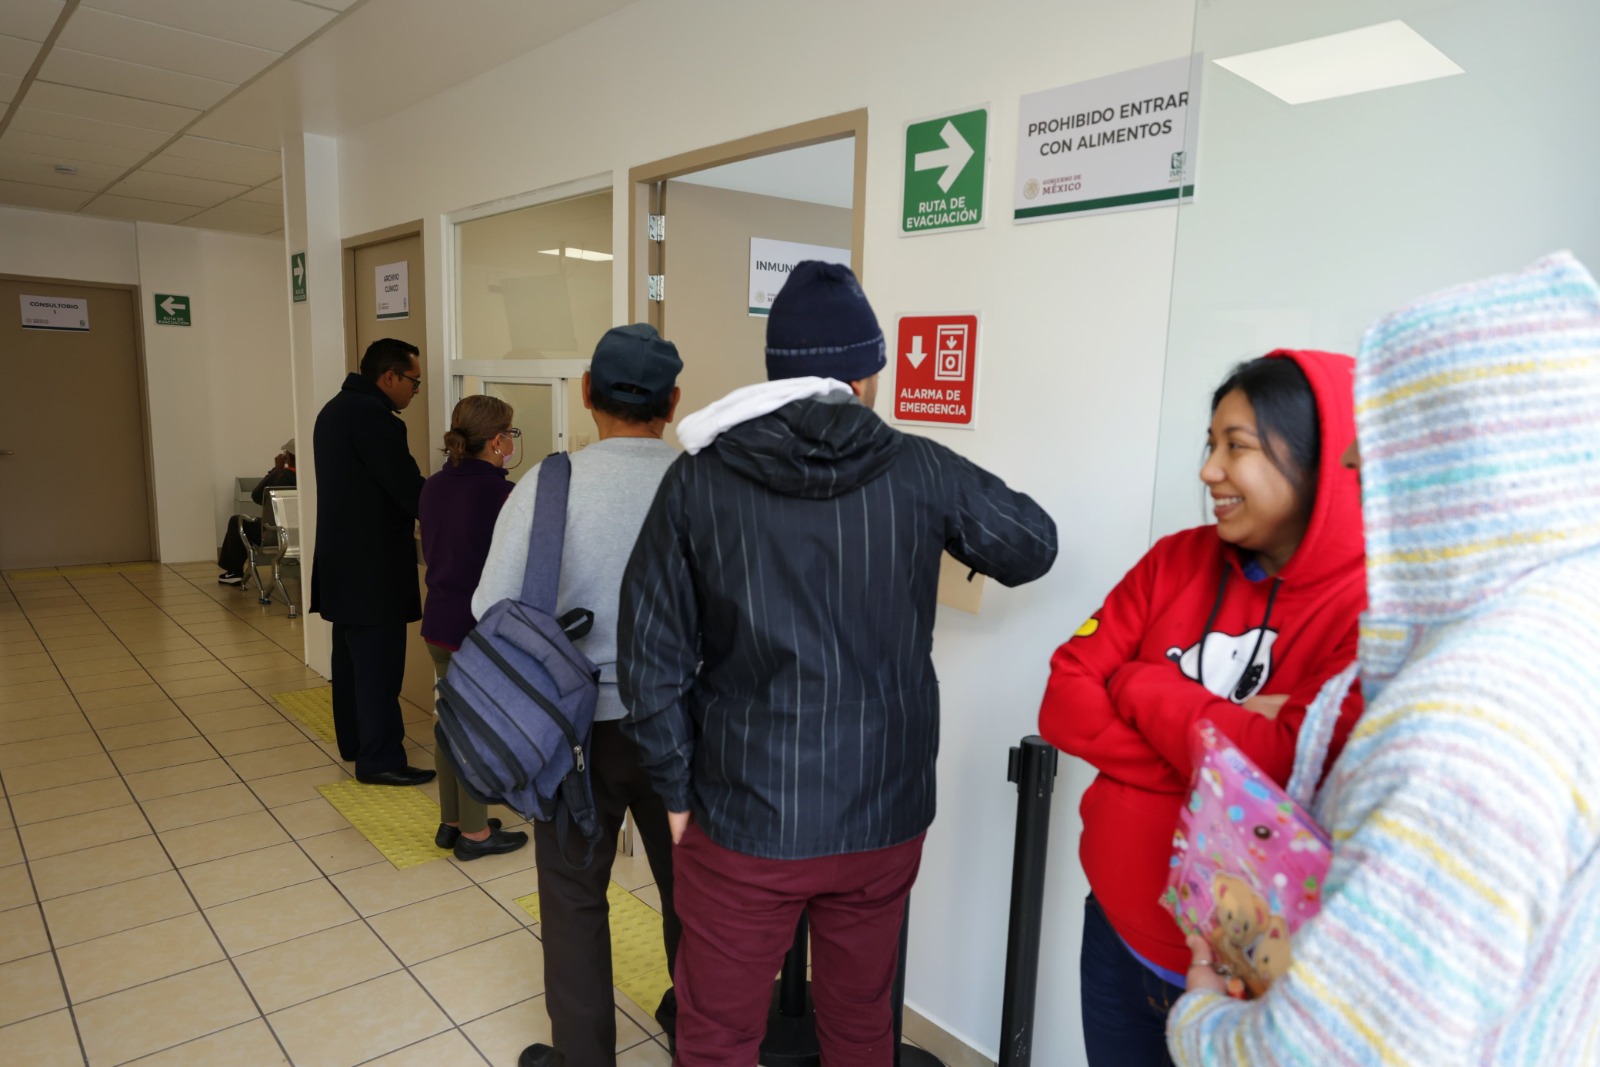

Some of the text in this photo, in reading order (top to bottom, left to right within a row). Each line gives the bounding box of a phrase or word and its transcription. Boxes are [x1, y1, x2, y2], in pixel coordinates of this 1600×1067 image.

[1028, 91, 1189, 137] PROHIBIDO ENTRAR
[1039, 119, 1173, 157] CON ALIMENTOS
[1042, 181, 1082, 195] MÉXICO
[918, 196, 966, 214] RUTA DE
[906, 207, 978, 229] EVACUACIÓN
[29, 301, 79, 310] CONSULTORIO
[900, 388, 961, 401] ALARMA DE
[900, 401, 967, 416] EMERGENCIA
